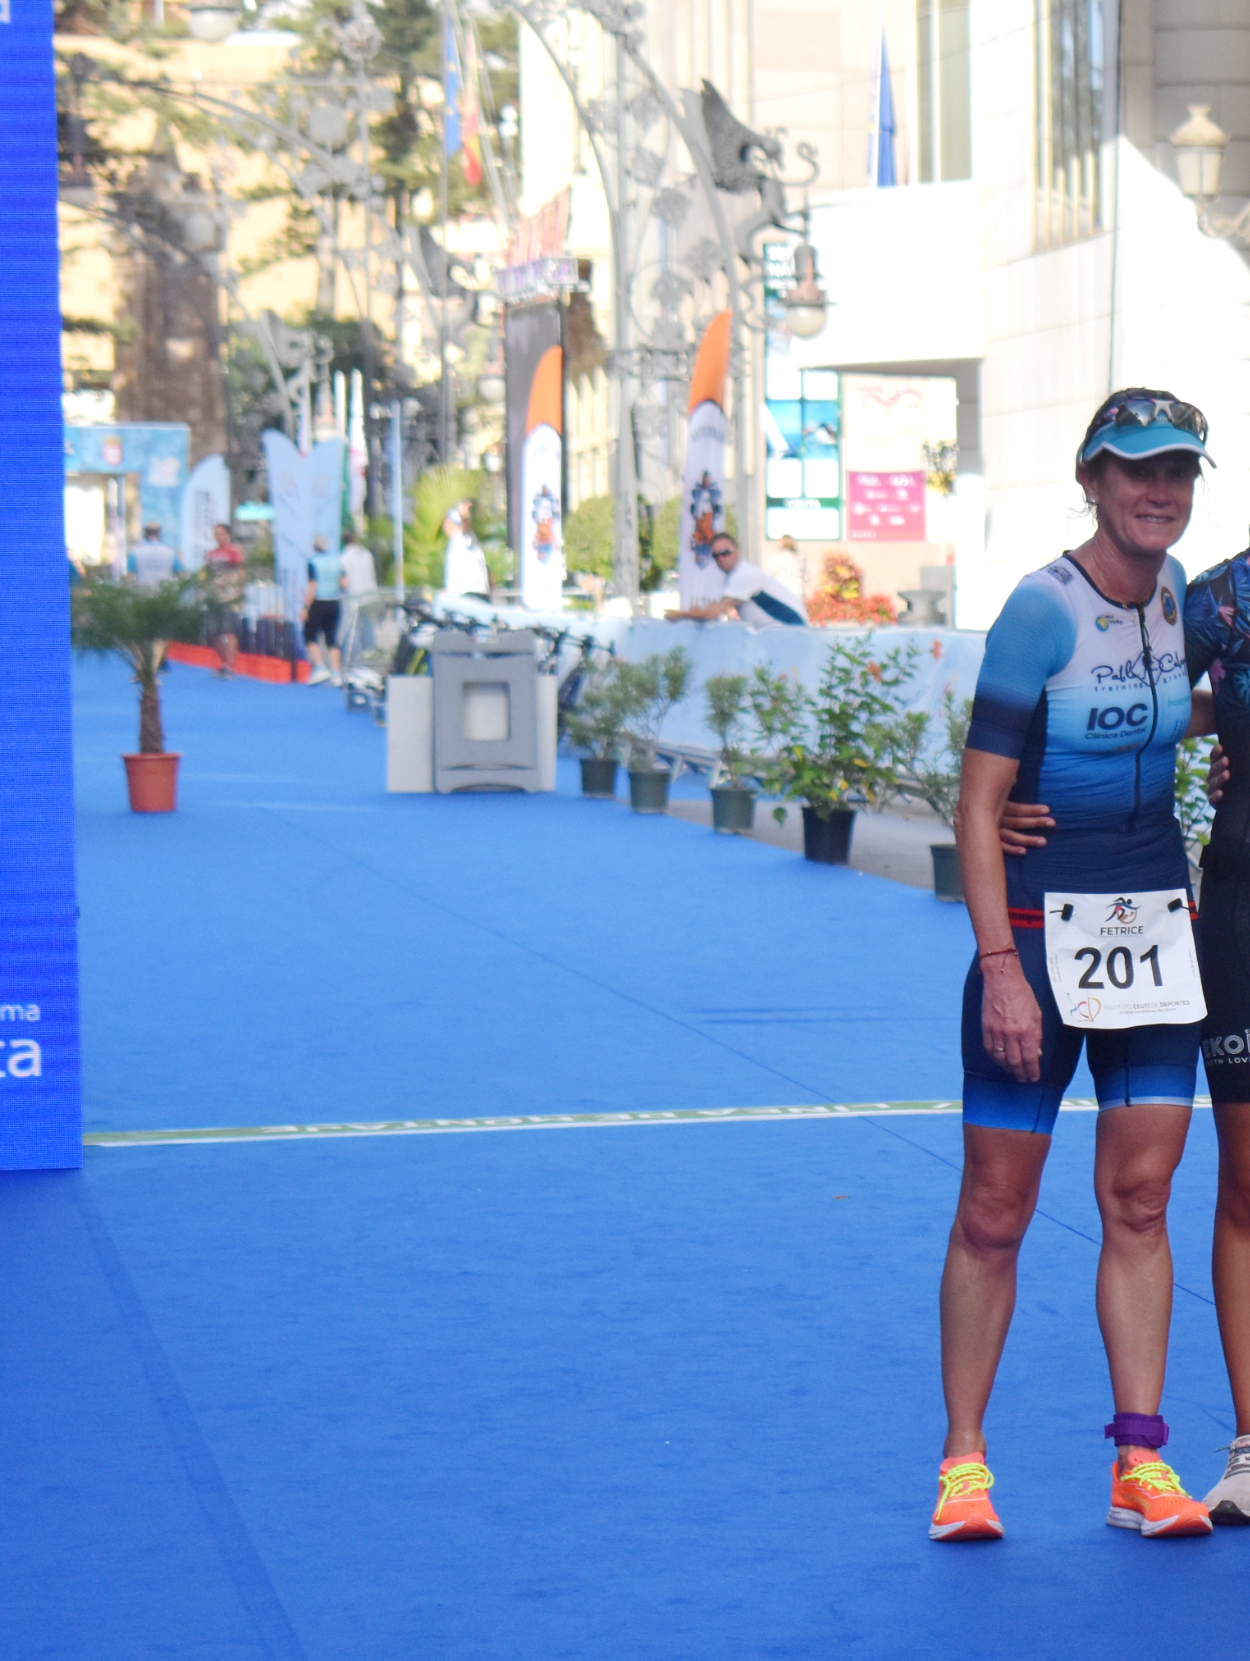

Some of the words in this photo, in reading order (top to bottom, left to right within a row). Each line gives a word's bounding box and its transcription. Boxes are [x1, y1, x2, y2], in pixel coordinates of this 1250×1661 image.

[1095, 682, 1144, 692] training
[1086, 703, 1148, 731] IOC
[1100, 926, 1144, 936] FETRICE
[1074, 944, 1163, 990] 201
[1160, 1000, 1190, 1008] DEPORTES
